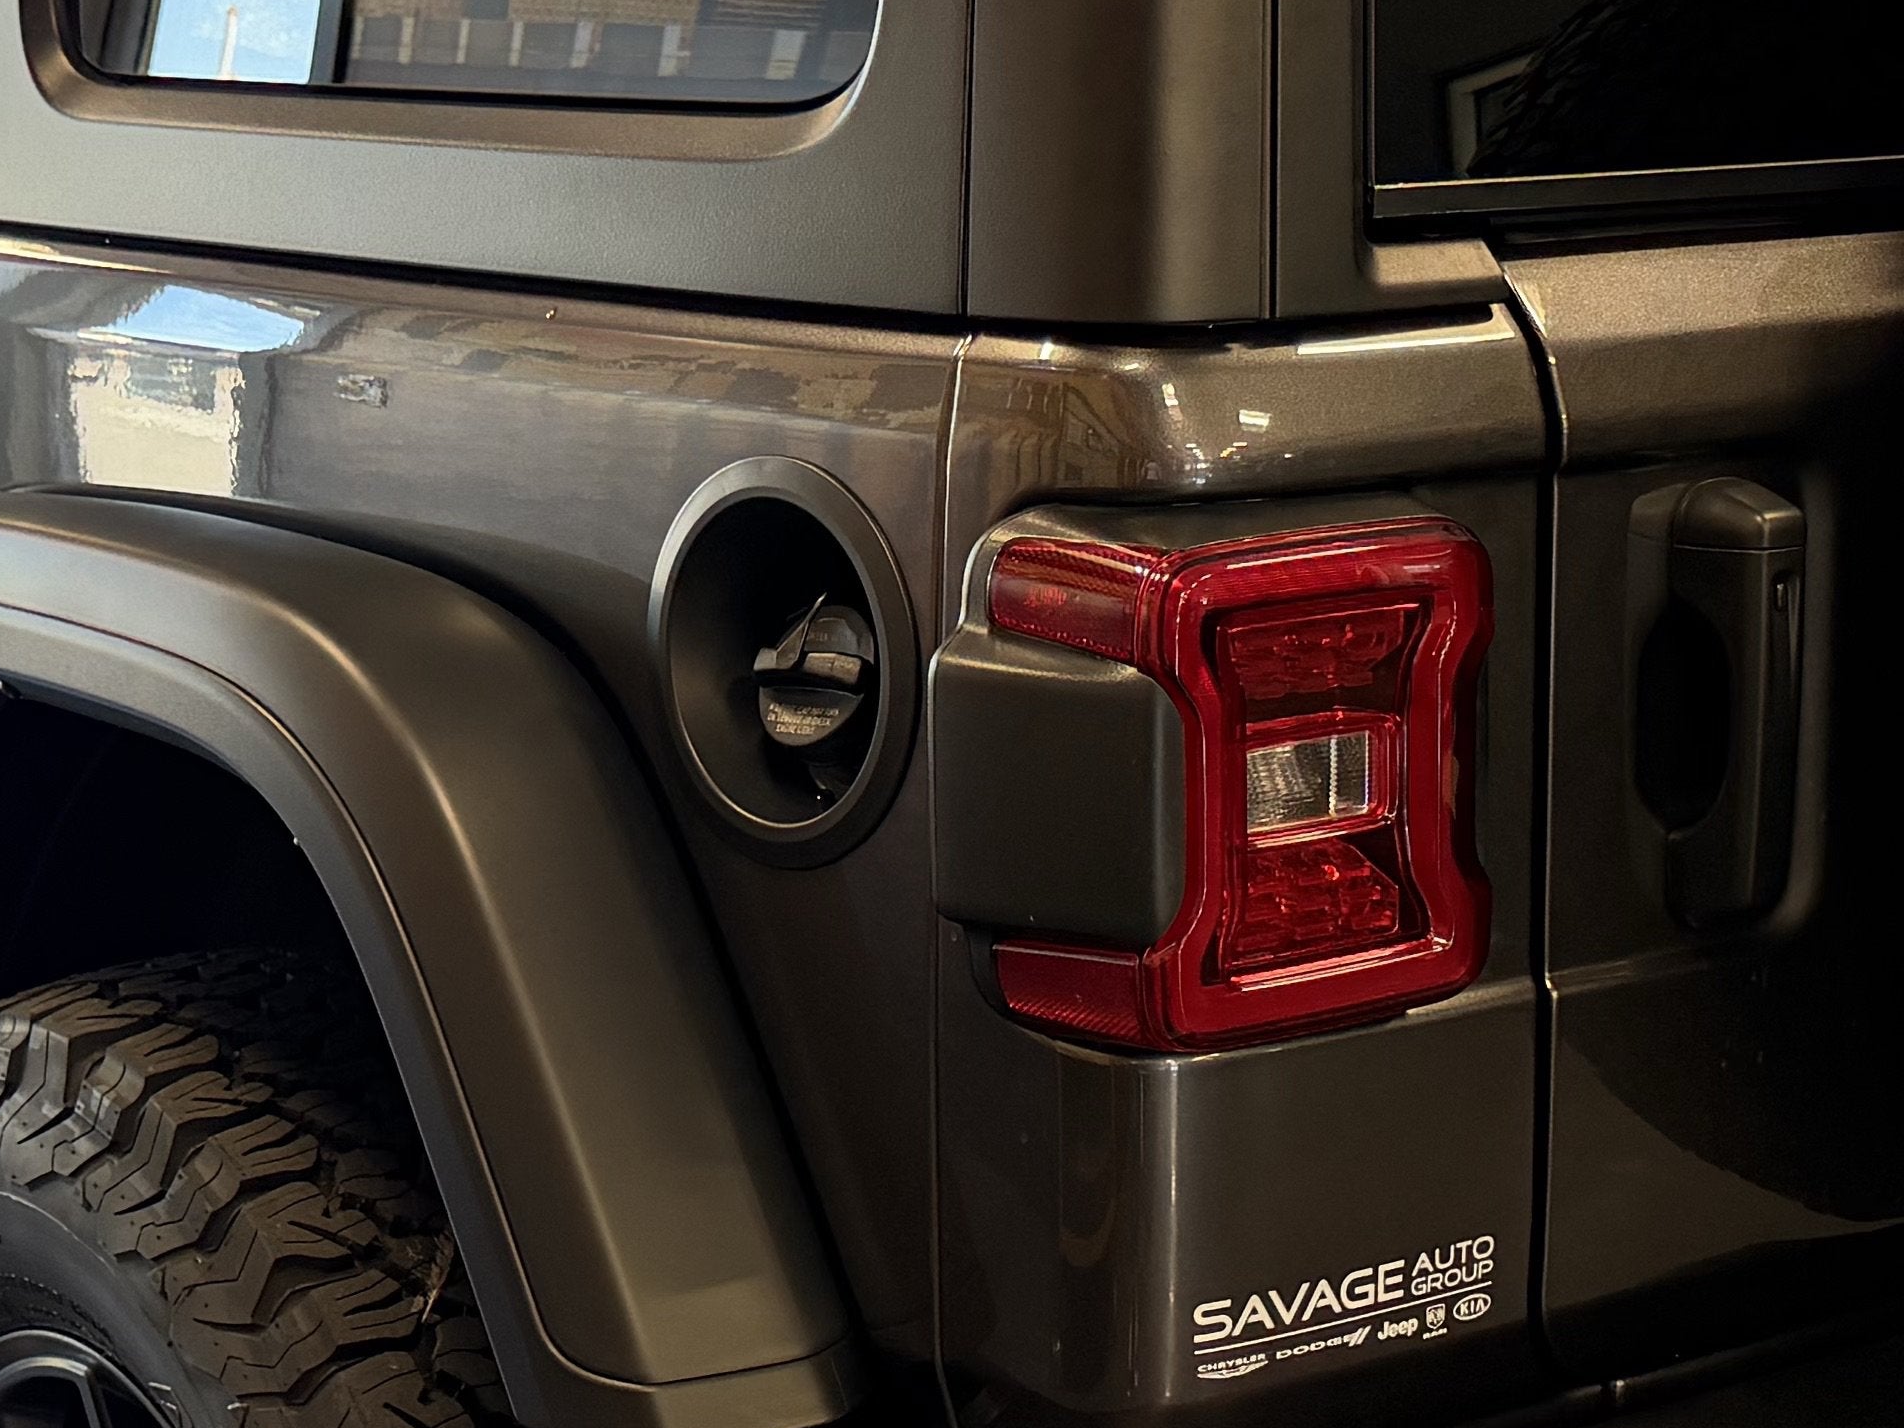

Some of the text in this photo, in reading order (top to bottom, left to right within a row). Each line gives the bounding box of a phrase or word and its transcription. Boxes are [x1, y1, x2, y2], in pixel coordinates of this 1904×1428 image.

[1411, 1259, 1494, 1297] GROUP
[1412, 1235, 1495, 1277] AUTO
[1193, 1259, 1405, 1343] SAVAGE
[1197, 1353, 1266, 1373] CHRYSLER
[1377, 1316, 1419, 1341] Jeep
[1456, 1296, 1489, 1318] KIA
